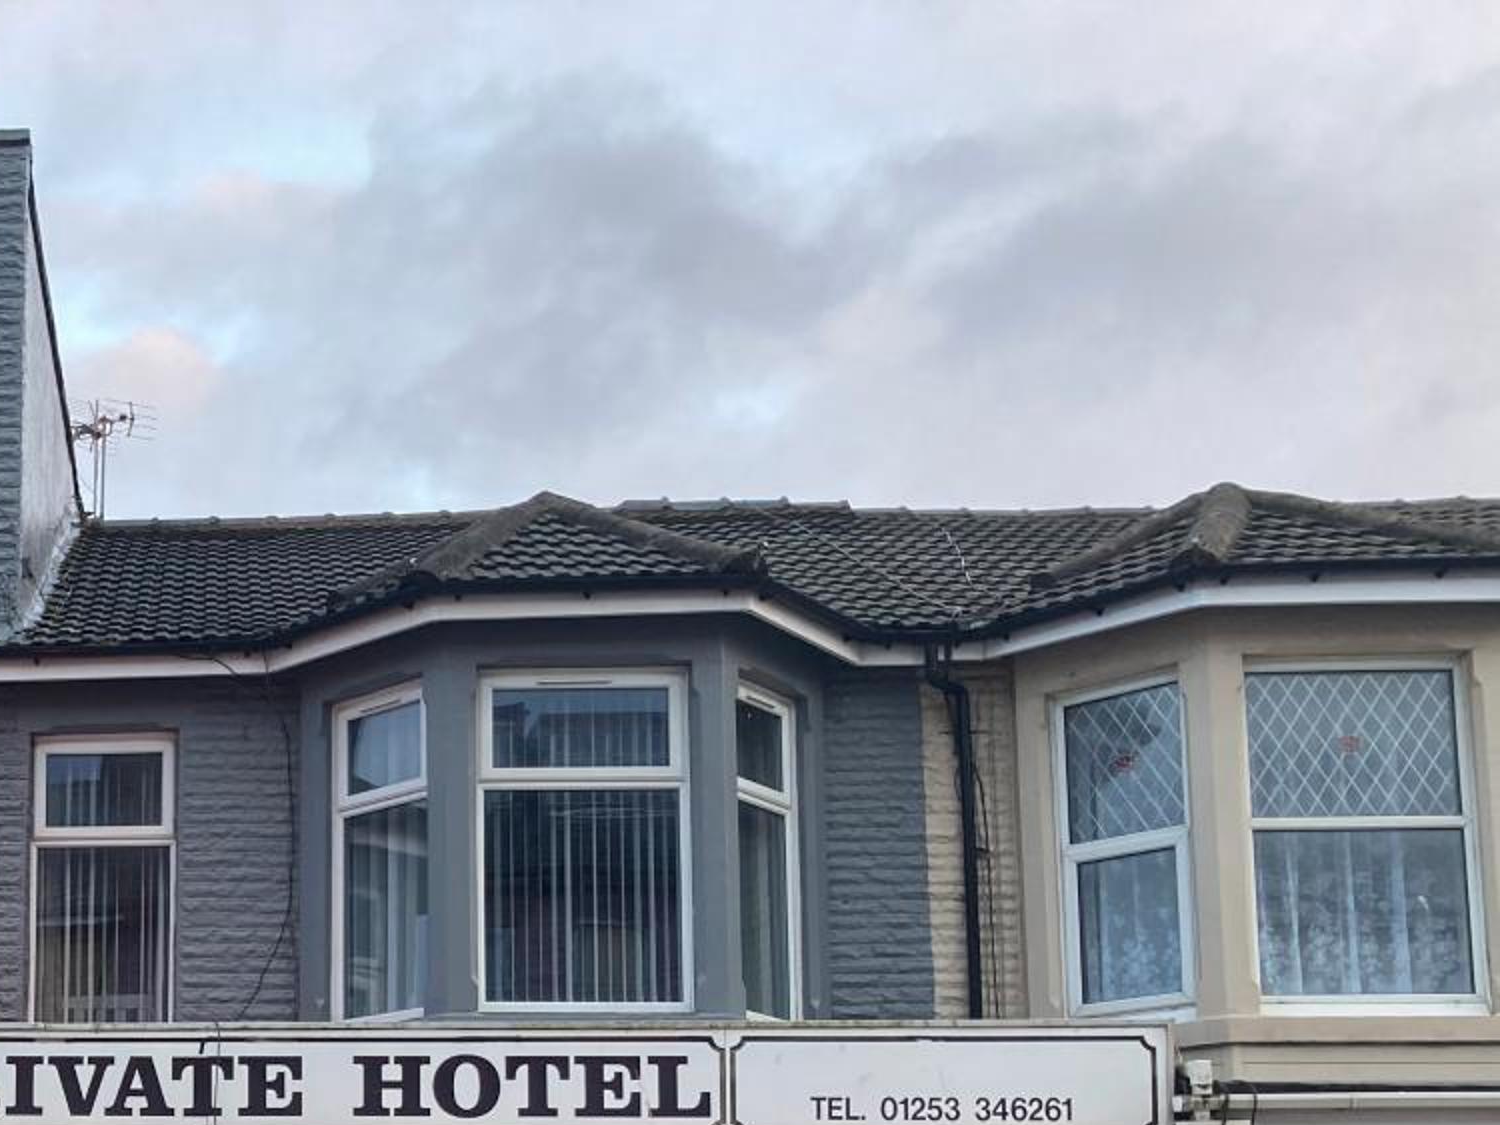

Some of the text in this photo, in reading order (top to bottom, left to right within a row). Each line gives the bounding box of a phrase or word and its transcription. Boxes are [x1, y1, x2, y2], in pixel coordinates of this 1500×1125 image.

[352, 1054, 712, 1119] HOTEL
[810, 1098, 1074, 1122] TEL. 01253 346261
